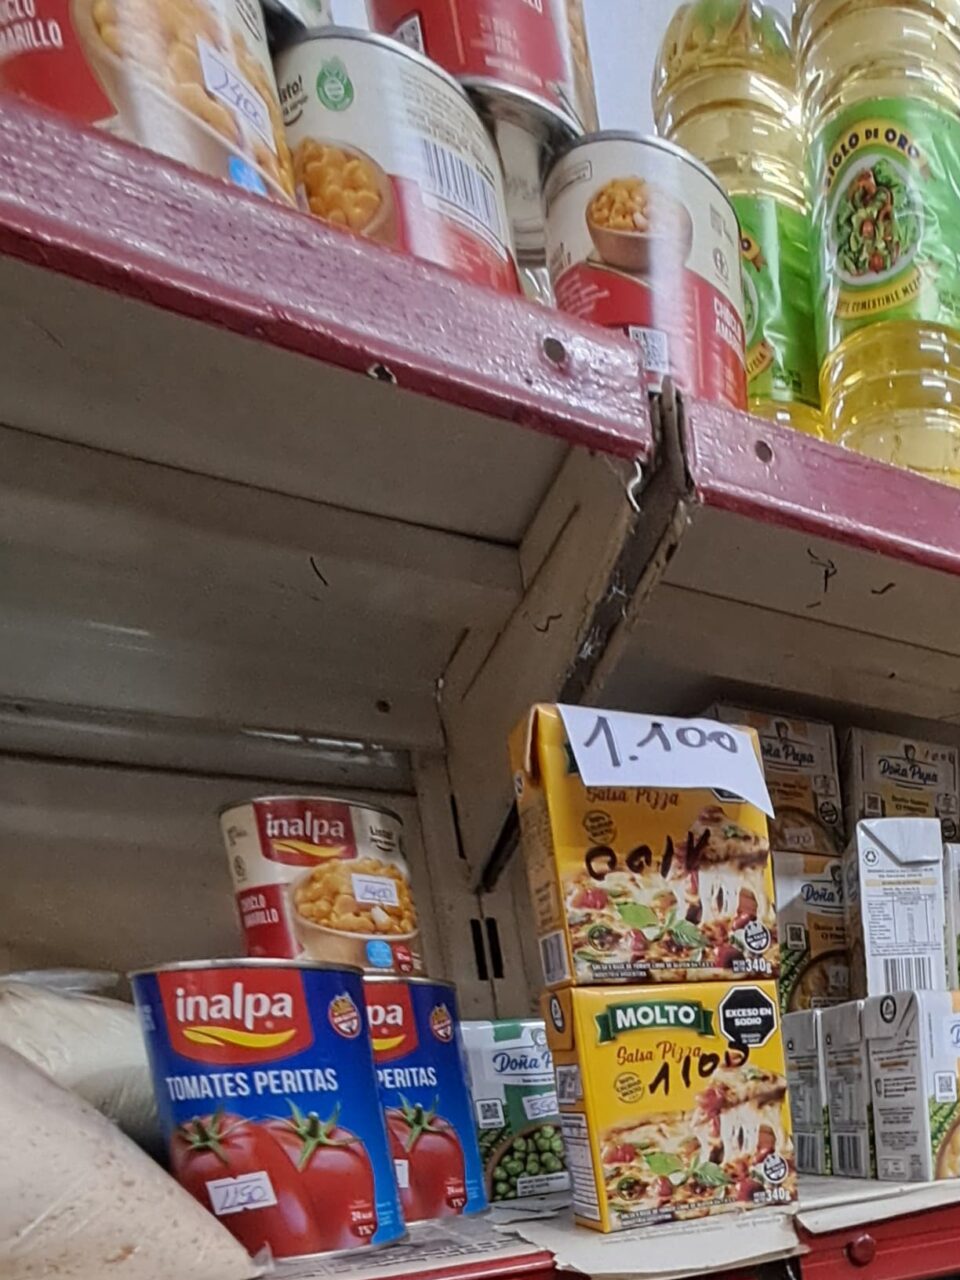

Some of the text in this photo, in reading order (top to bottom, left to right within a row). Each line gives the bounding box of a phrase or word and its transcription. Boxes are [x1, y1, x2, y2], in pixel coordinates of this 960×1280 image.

[865, 128, 878, 139] DE
[583, 716, 739, 768] 1.100
[878, 758, 908, 775] Doña
[265, 811, 345, 844] inalpa
[801, 882, 835, 903] Doña
[175, 982, 294, 1030] inalpa
[615, 1004, 697, 1030] MOLTO
[725, 1007, 772, 1018] EXCESO EN
[734, 1016, 762, 1027] SODIO
[493, 1052, 539, 1073] Doña
[616, 1040, 703, 1066] Salsa Pizza
[166, 1068, 339, 1101] TOMATES PERITAS
